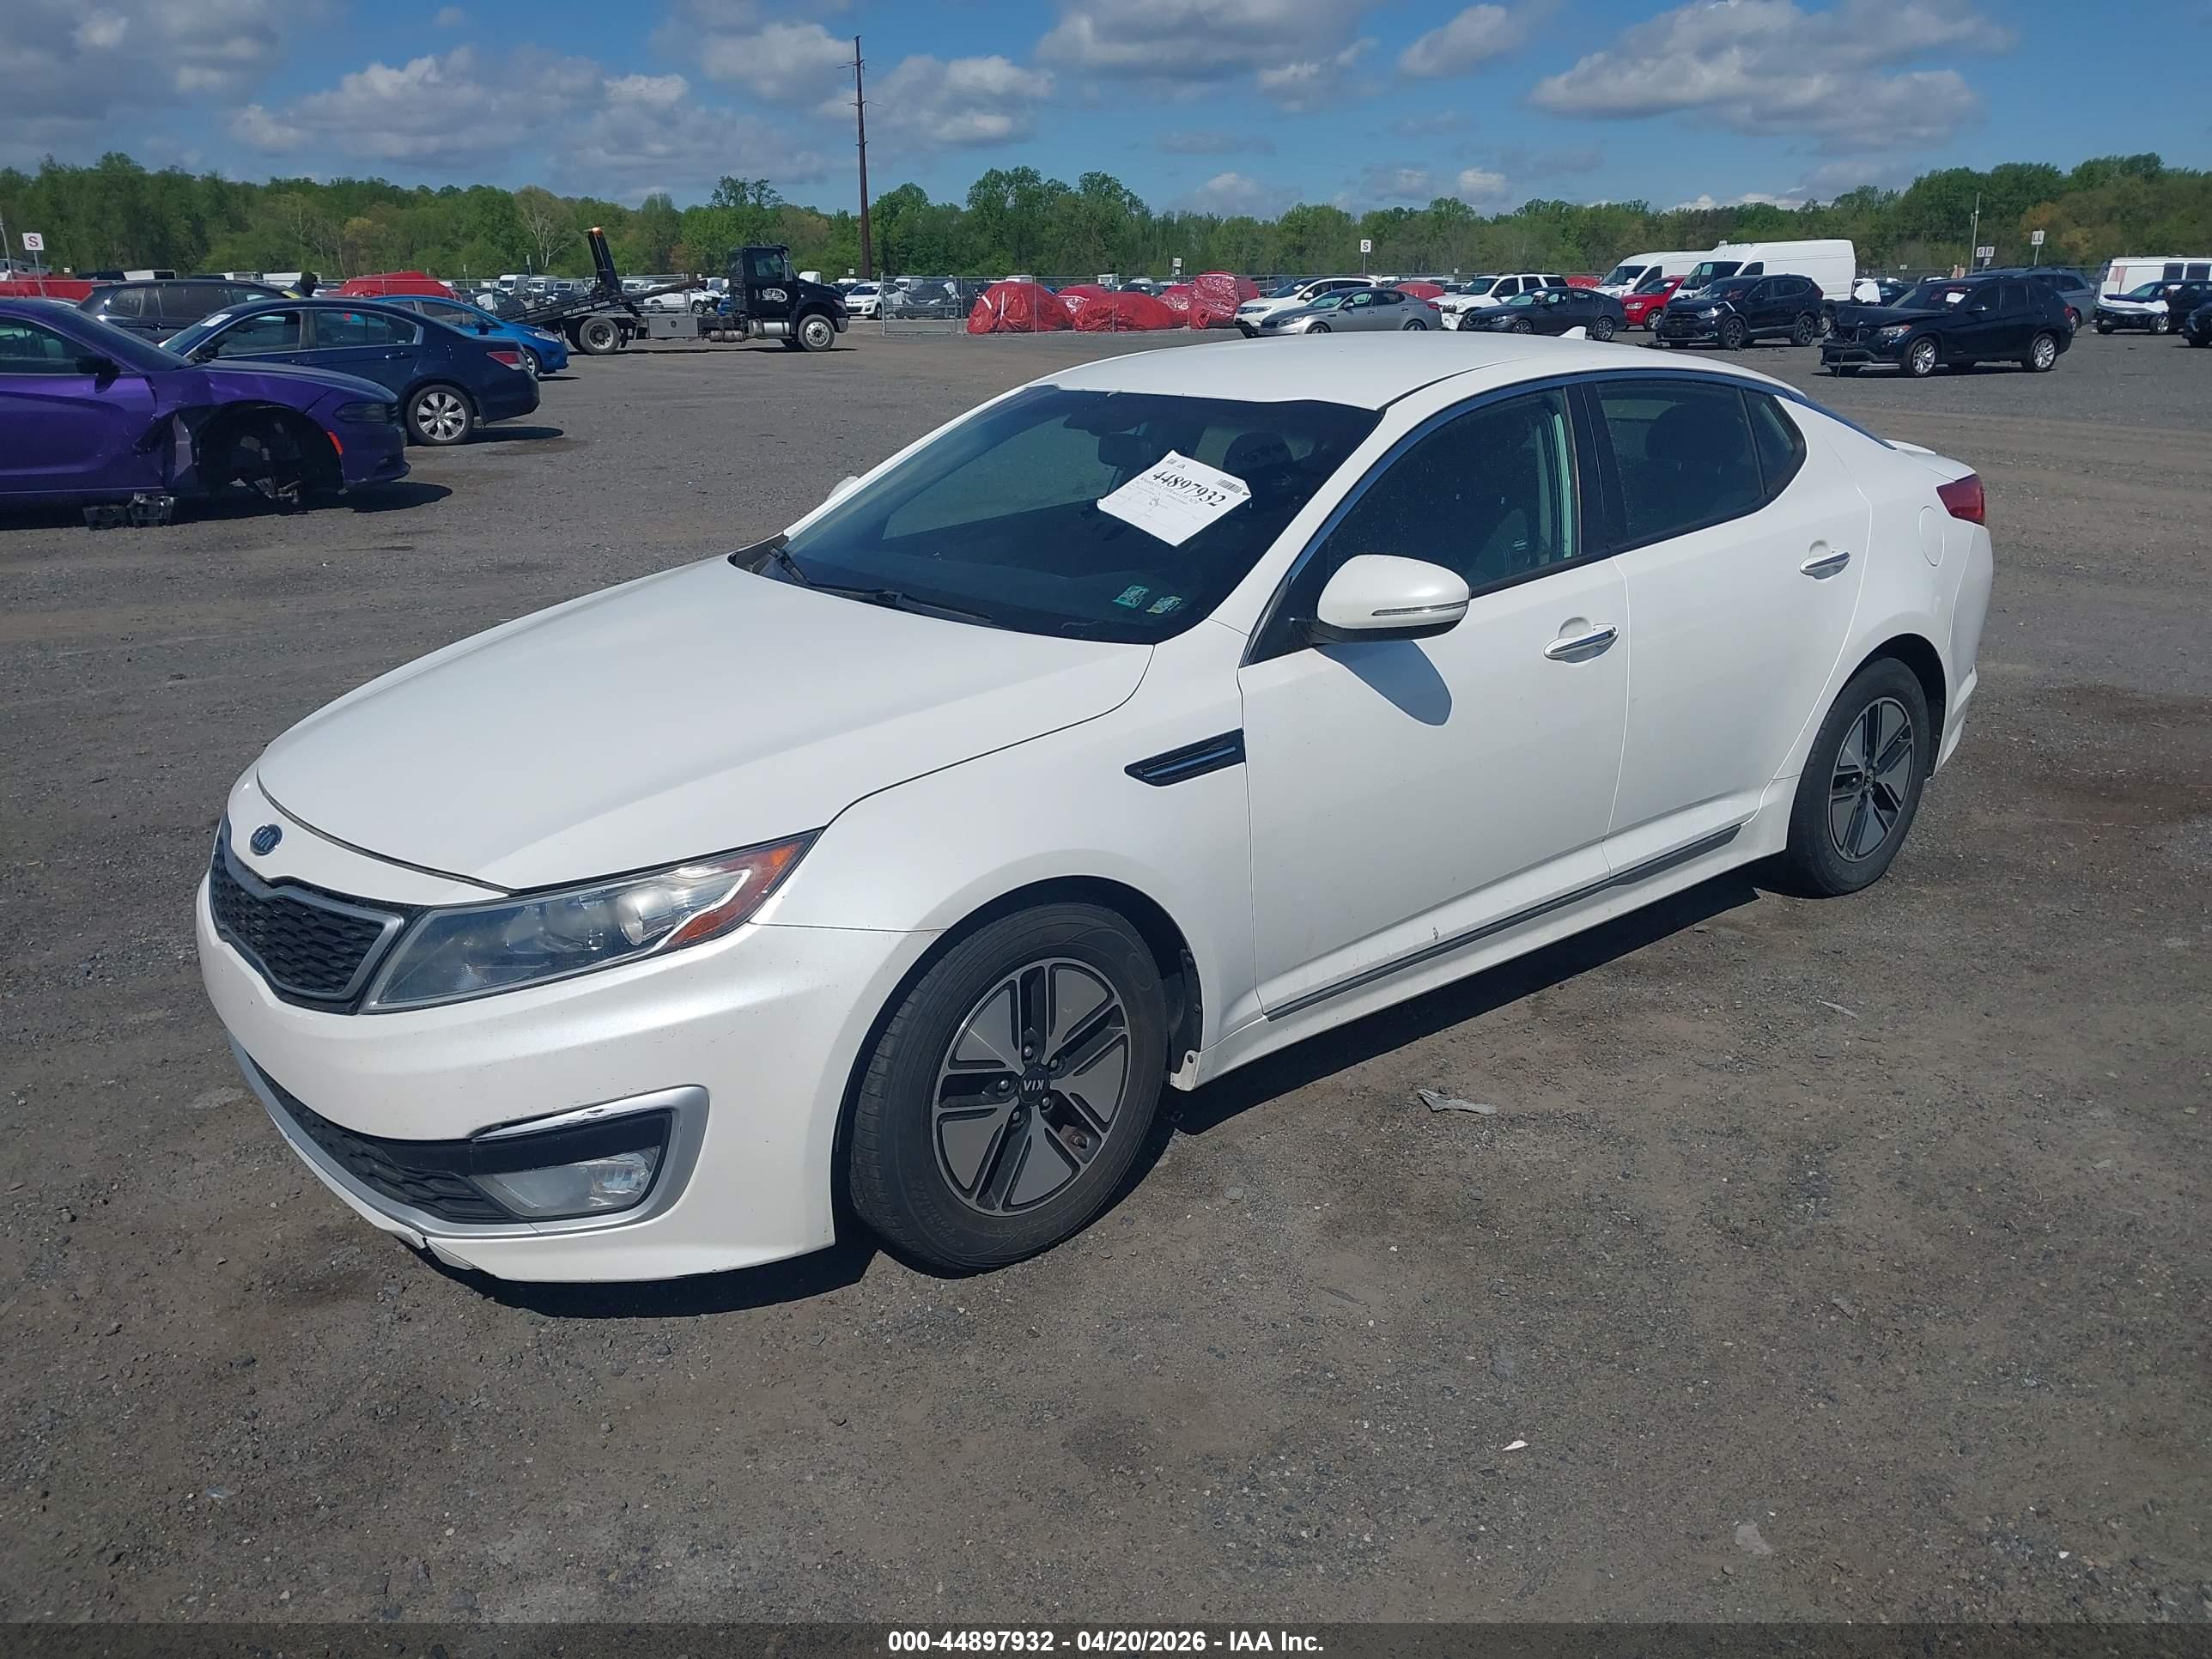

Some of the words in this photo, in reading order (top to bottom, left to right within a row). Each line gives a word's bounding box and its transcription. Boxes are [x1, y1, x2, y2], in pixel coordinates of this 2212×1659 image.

[27, 235, 39, 247] S
[2033, 233, 2043, 242] LL
[1363, 241, 1369, 251] S
[1152, 470, 1227, 507] 44897932
[1023, 1079, 1045, 1091] KIA
